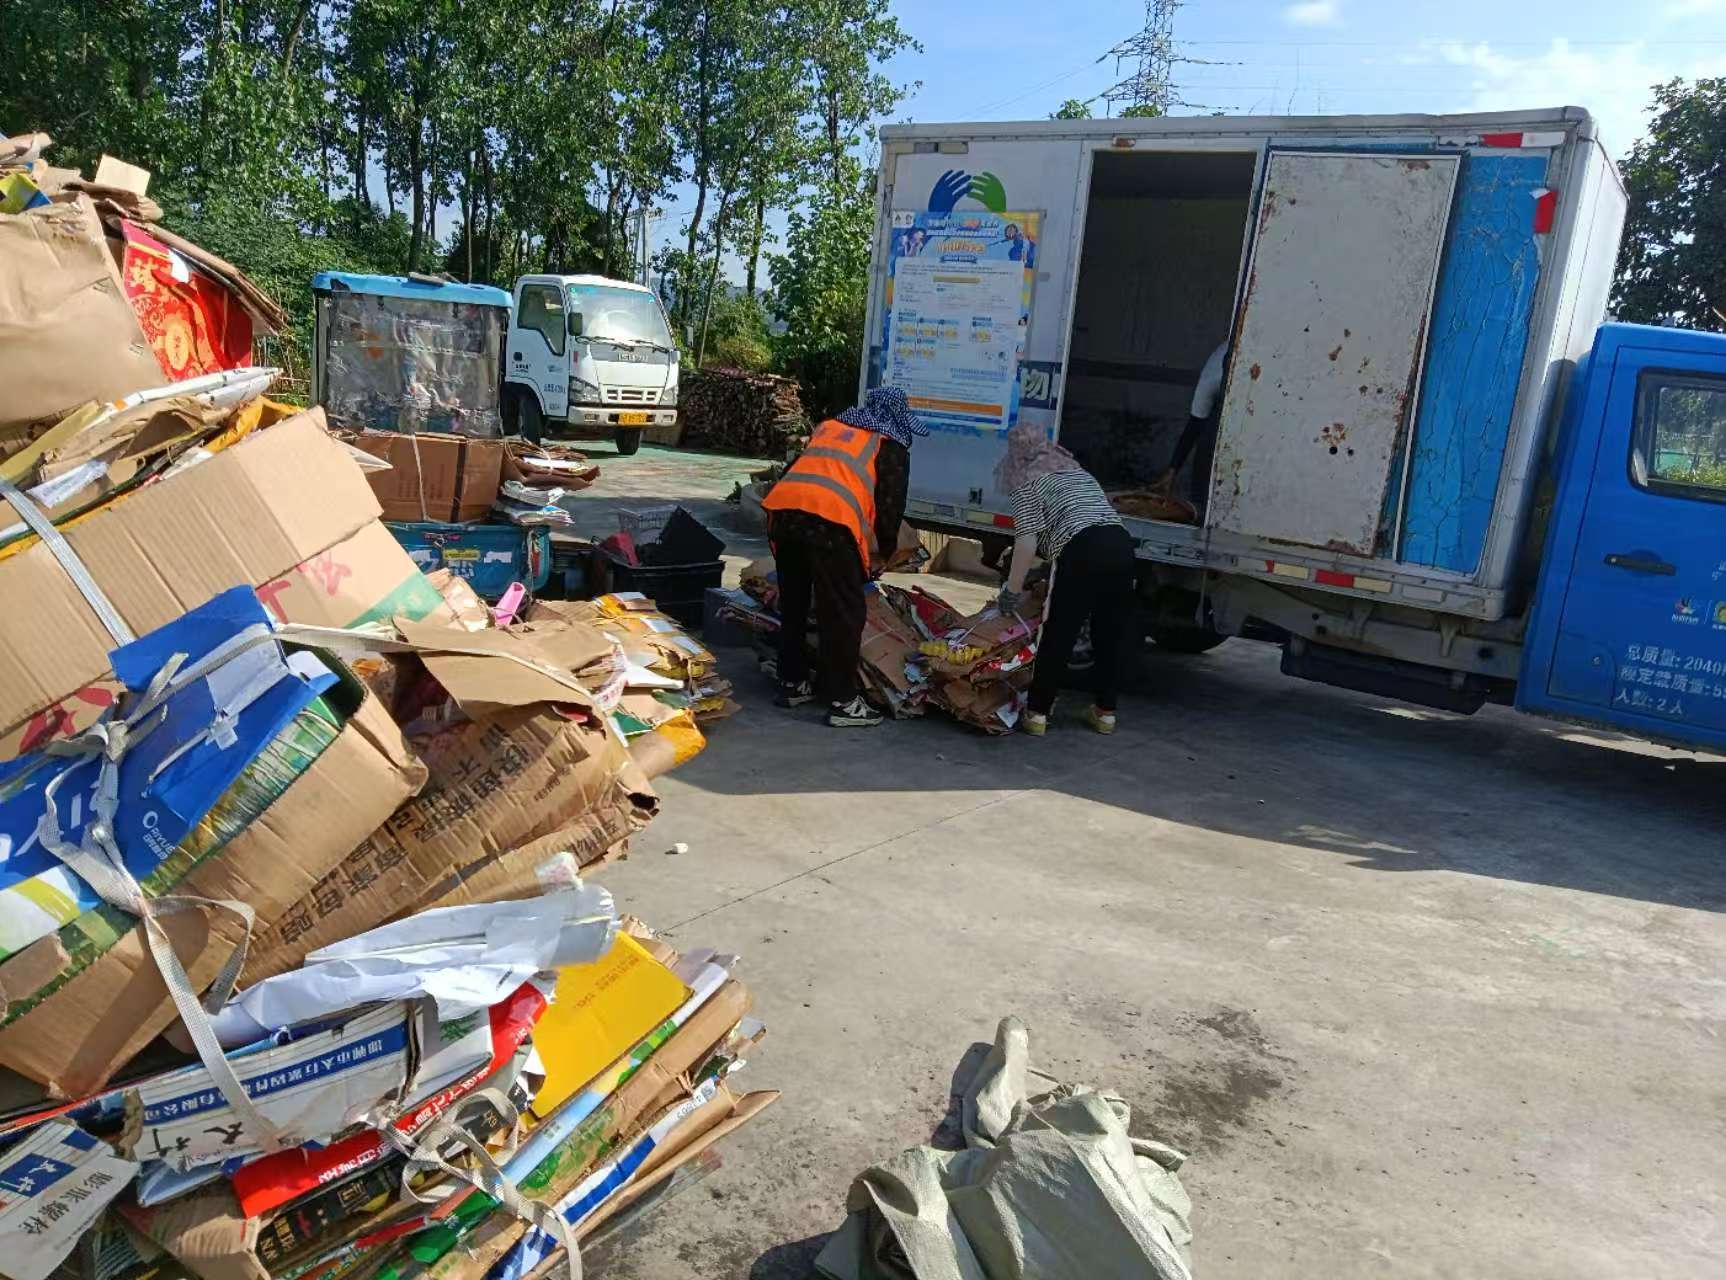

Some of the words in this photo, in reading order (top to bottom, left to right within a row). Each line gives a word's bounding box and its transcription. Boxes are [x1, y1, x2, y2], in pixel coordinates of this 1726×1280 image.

[145, 1039, 383, 1121] 邯郸市太行紧固件有限公司
